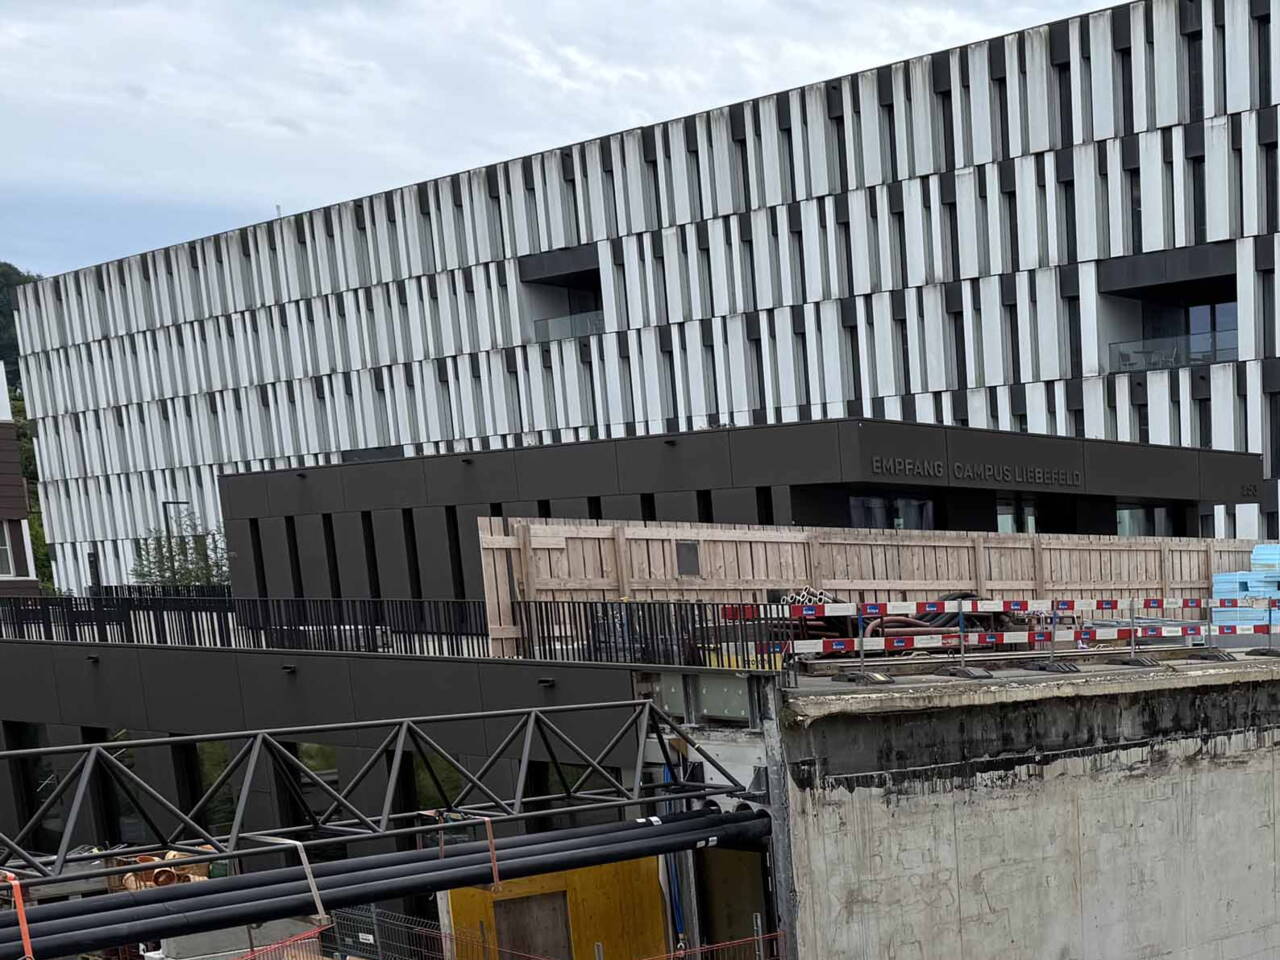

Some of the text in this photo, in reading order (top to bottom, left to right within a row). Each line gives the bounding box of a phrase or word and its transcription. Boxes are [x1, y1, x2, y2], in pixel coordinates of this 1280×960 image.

[872, 455, 1081, 486] EMPFANG CAMPUS LIEBEFELD
